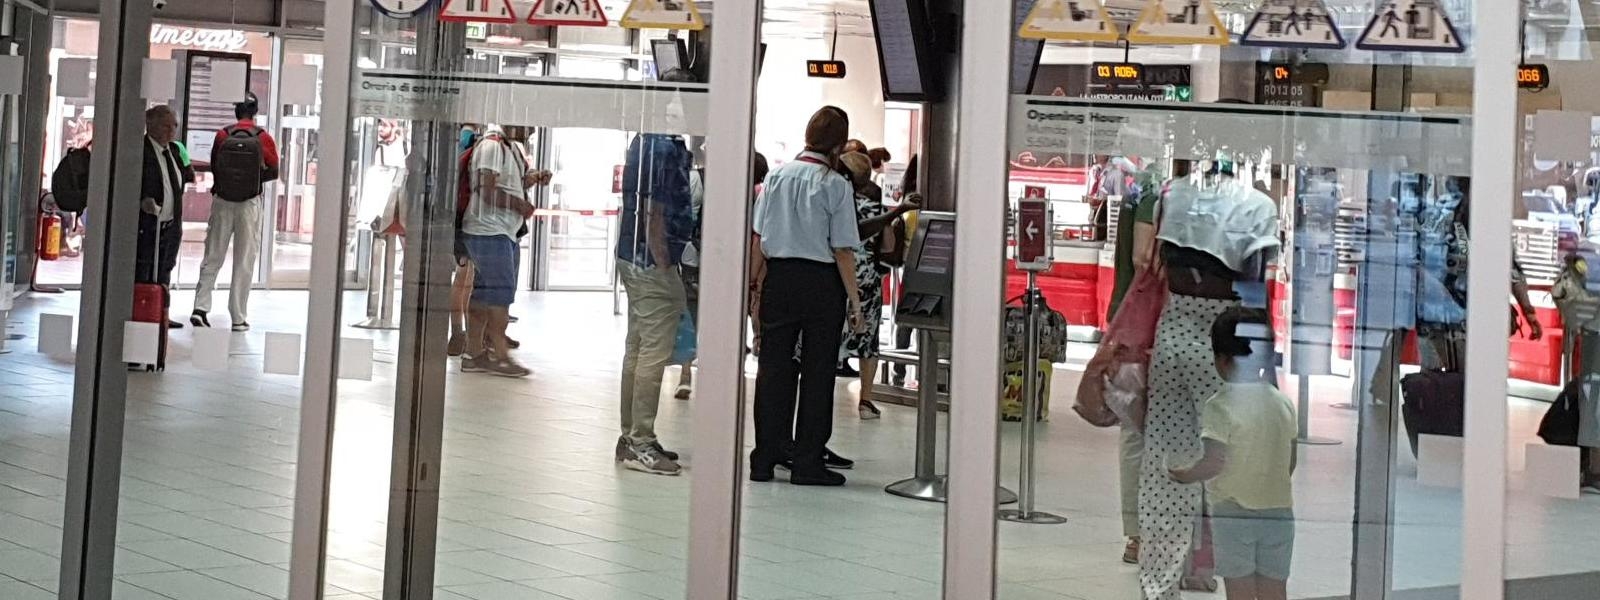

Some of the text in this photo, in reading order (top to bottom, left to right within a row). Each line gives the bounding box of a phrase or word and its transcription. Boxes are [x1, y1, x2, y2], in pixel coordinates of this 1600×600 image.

[1098, 66, 1110, 76] 03
[1114, 66, 1138, 78] R064
[1275, 67, 1288, 79] 04
[1291, 86, 1303, 96] 05
[1027, 109, 1085, 124] Opening
